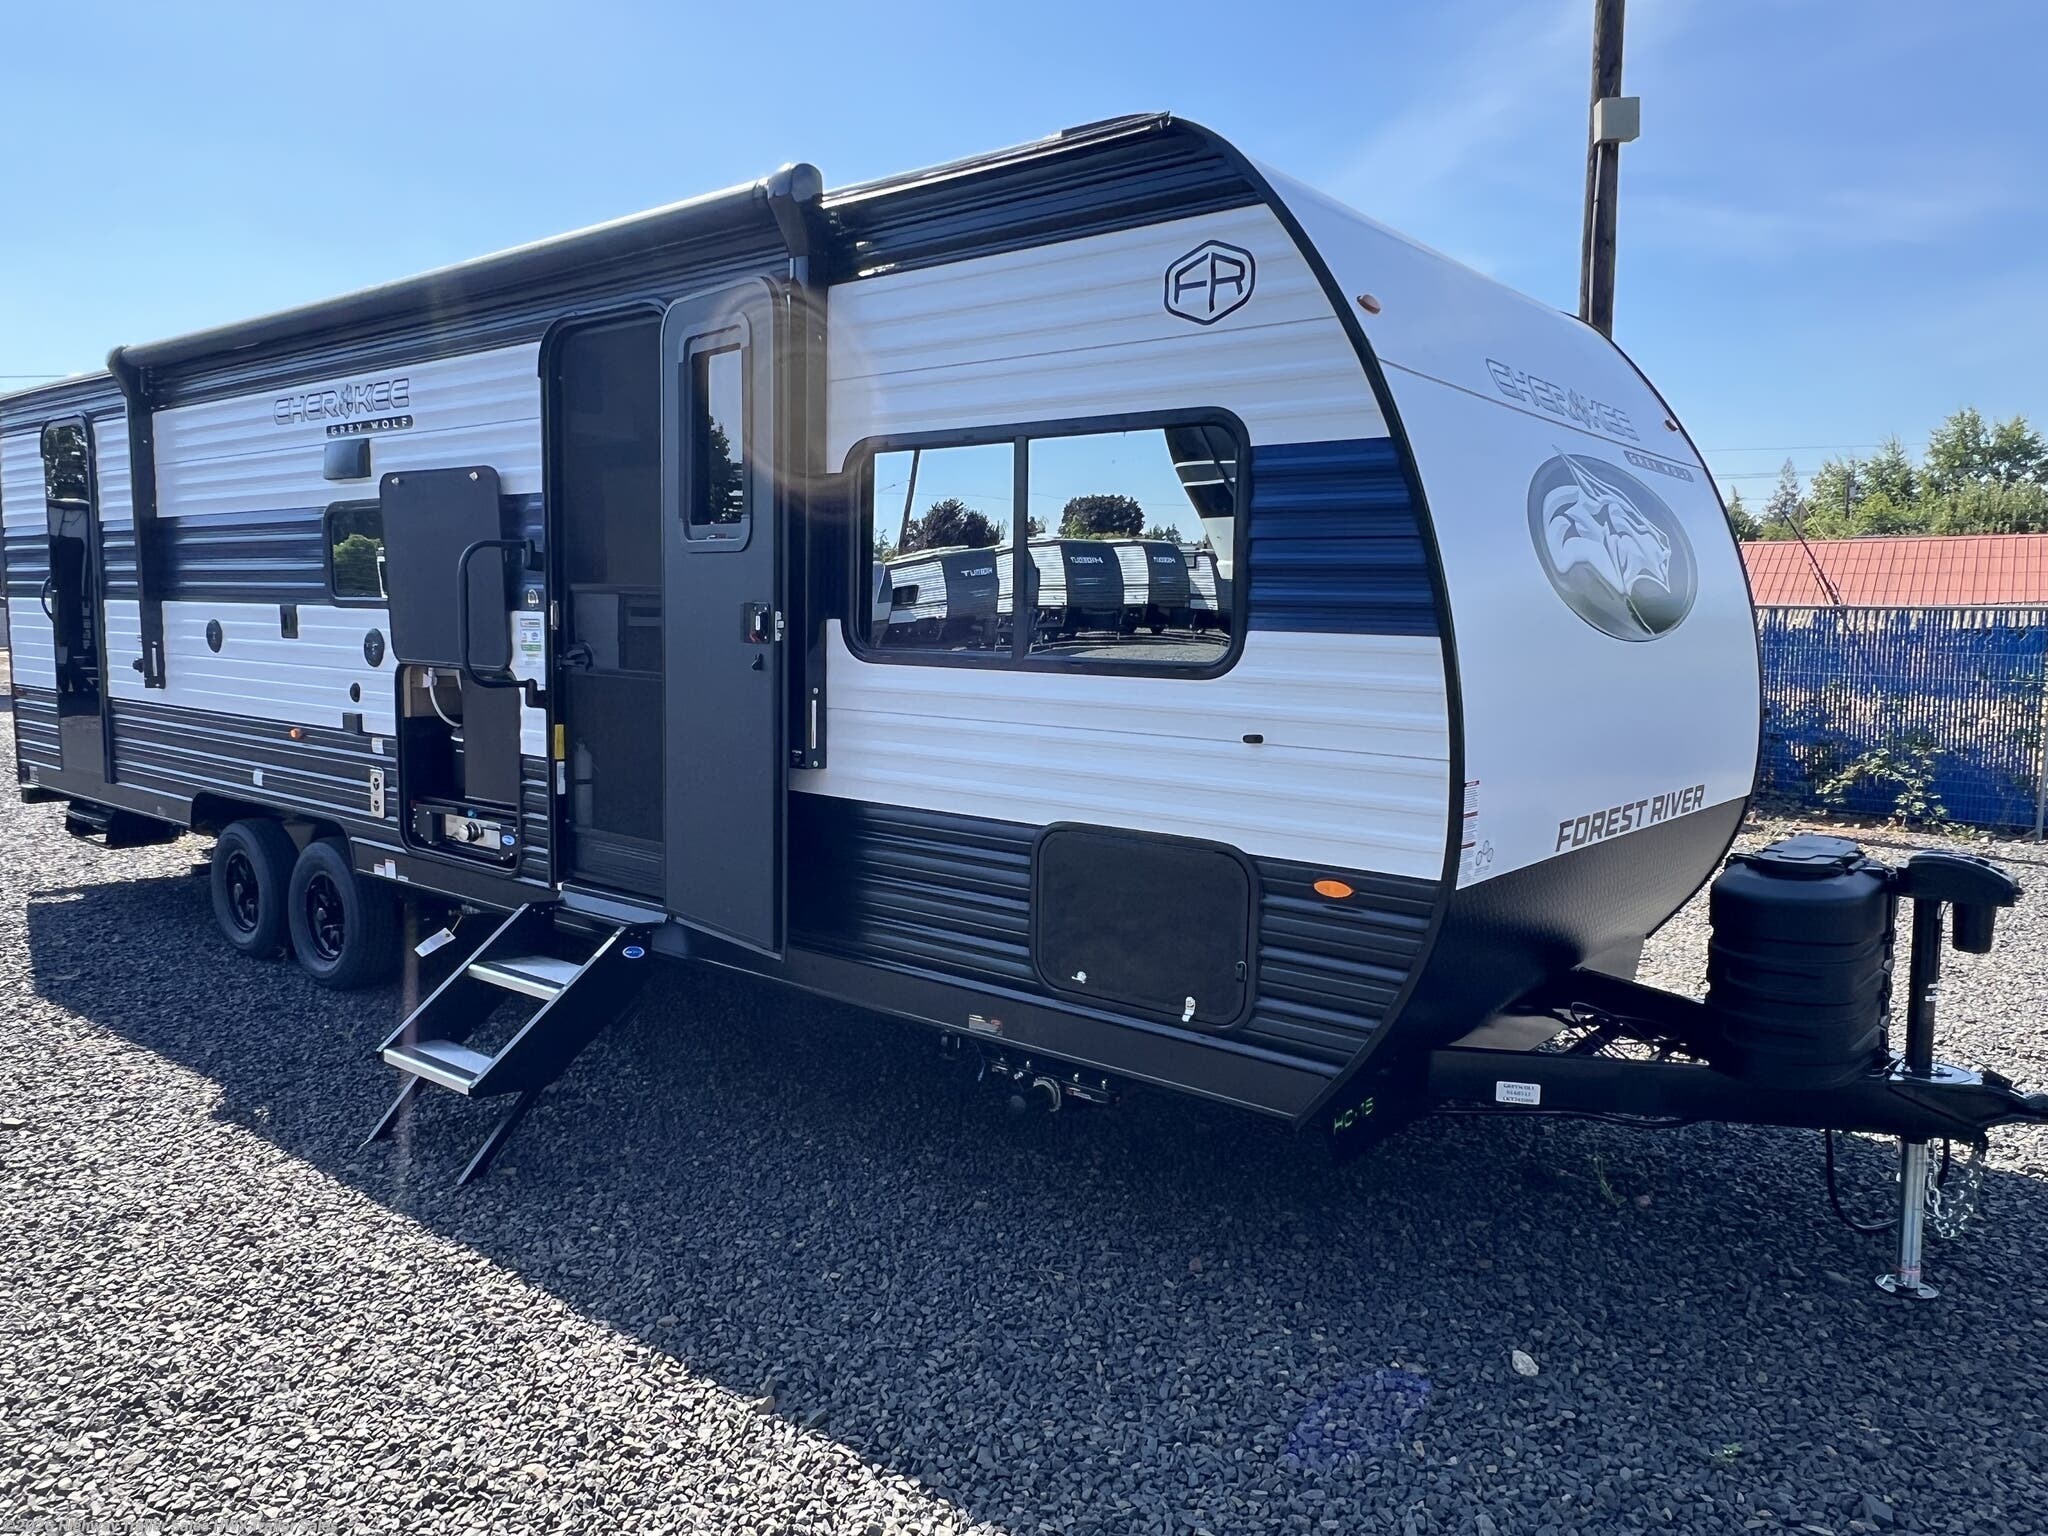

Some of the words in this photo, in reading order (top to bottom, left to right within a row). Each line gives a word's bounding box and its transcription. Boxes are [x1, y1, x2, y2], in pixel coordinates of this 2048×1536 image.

[1174, 252, 1245, 313] FR
[273, 378, 409, 426] CHEROKEE
[331, 423, 363, 435] GREY
[370, 417, 408, 430] WOLF
[1555, 799, 1649, 852] FOREST
[1650, 784, 1706, 824] RIVER
